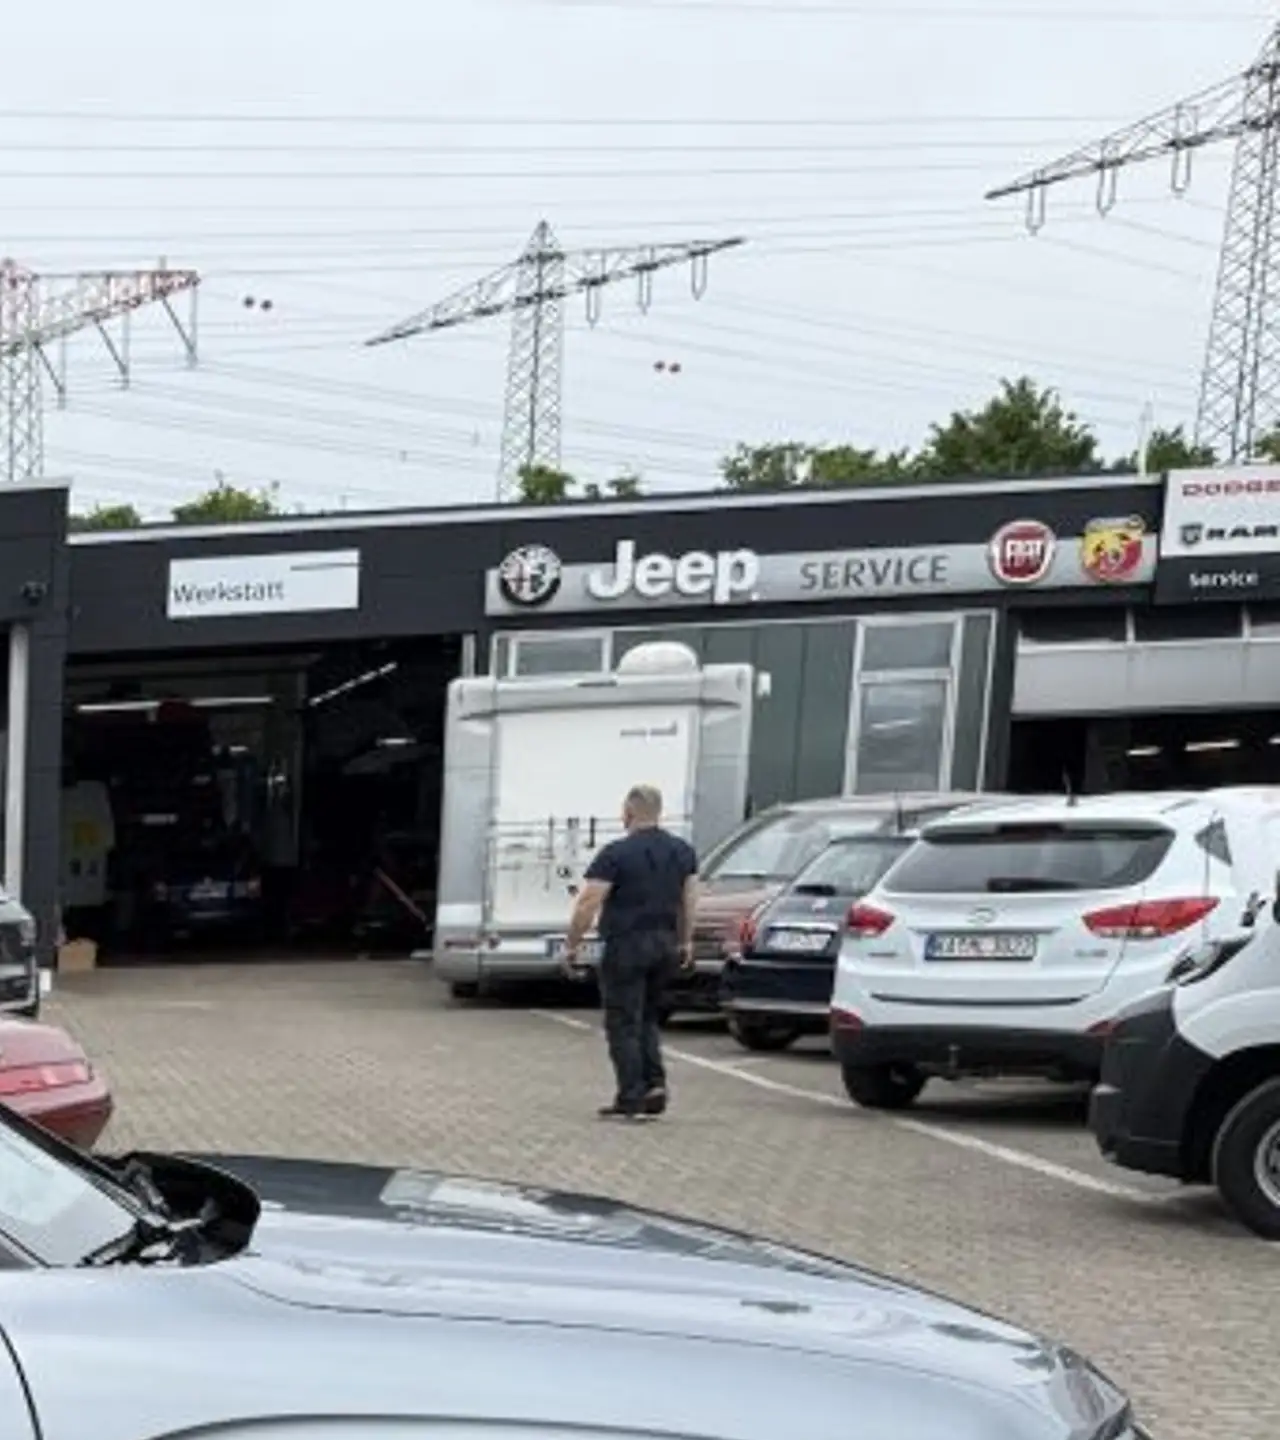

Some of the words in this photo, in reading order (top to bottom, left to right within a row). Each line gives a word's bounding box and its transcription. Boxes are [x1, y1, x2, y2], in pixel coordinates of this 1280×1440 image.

[1206, 525, 1278, 540] RAM
[1005, 540, 1044, 568] FIAT
[588, 540, 759, 602] Jeep
[800, 554, 949, 591] SERVICE
[174, 581, 284, 605] Werkstatt
